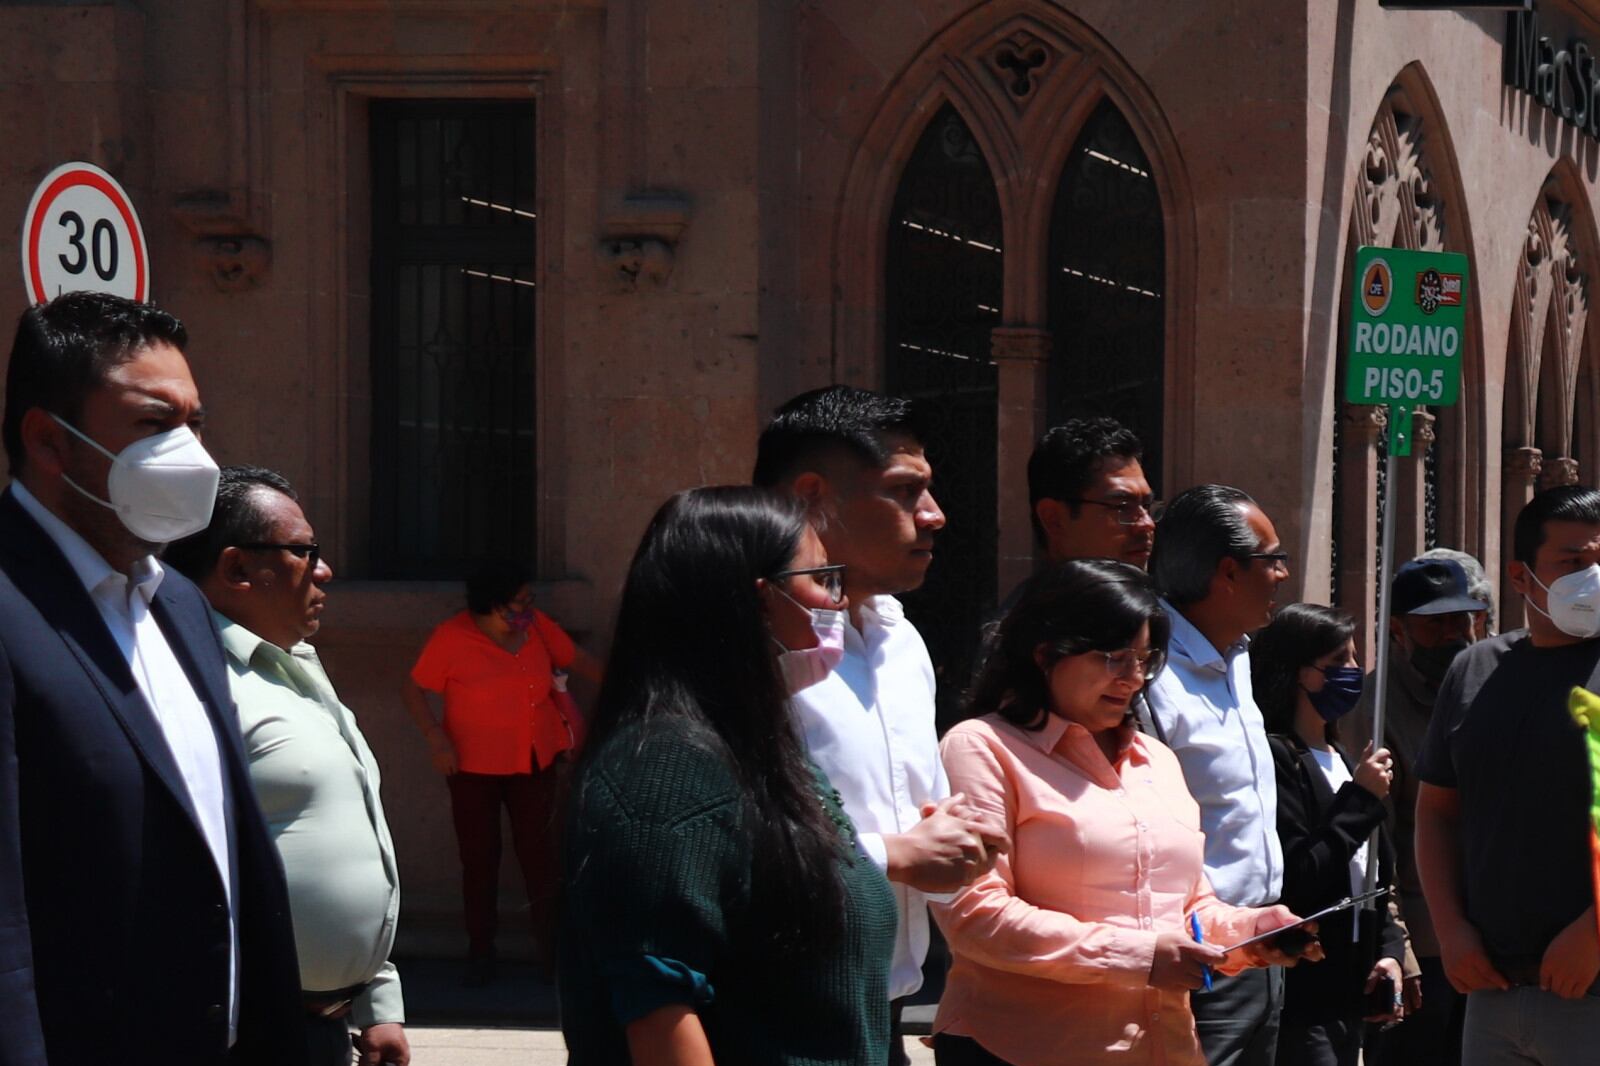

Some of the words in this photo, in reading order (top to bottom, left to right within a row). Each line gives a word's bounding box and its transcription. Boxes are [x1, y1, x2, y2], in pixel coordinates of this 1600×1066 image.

[58, 211, 118, 282] 30
[1355, 322, 1459, 358] RODANO
[1364, 367, 1444, 400] PISO-5
